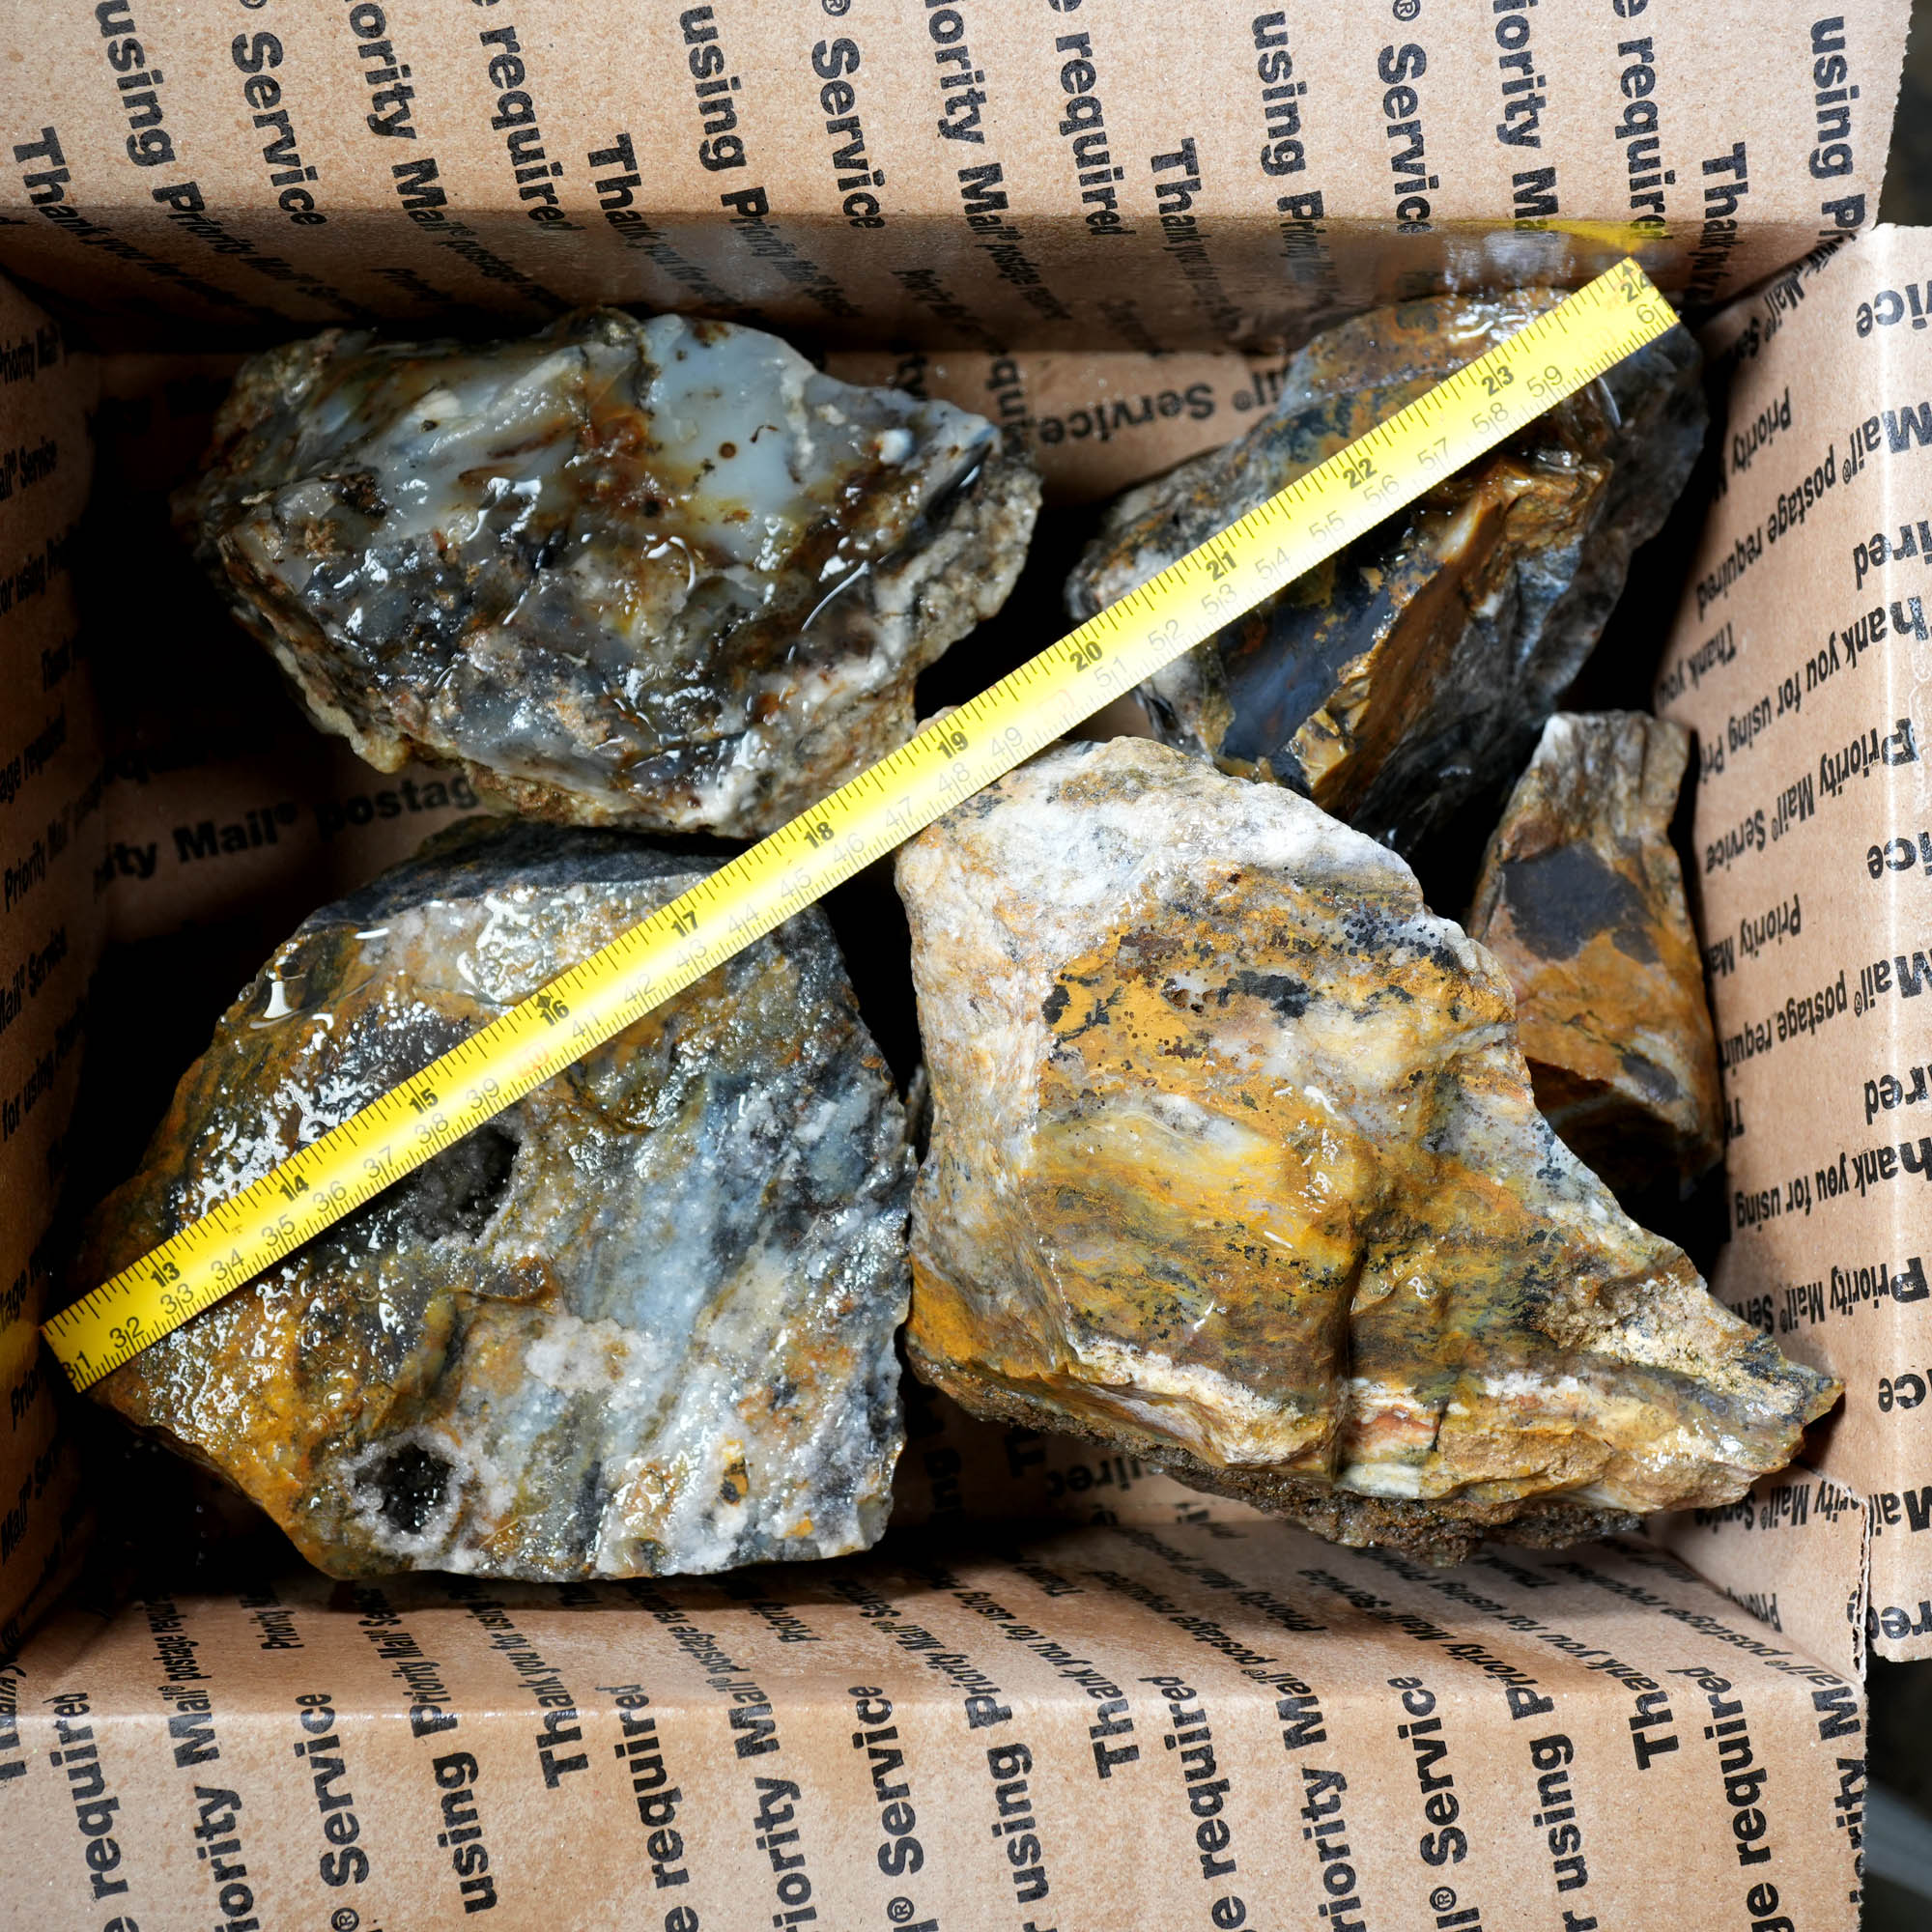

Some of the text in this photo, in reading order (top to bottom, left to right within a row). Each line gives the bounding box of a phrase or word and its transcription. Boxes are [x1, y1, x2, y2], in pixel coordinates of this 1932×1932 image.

[346, 0, 417, 141] ority
[1251, 11, 1307, 177] using
[1809, 15, 1860, 179] using
[13, 127, 112, 236] Thank
[95, 0, 177, 167] using
[152, 181, 259, 254] Priority
[231, 31, 328, 226] Service
[479, 25, 585, 231] required
[679, 5, 798, 259] using Priority
[811, 37, 886, 228] Service
[1055, 32, 1136, 236] required
[1378, 43, 1439, 234] Service
[1615, 36, 1676, 239] require
[587, 132, 668, 241] Thank
[1151, 137, 1210, 243] Thank
[1038, 382, 1216, 444] Service
[1730, 386, 1793, 474] Priority
[1768, 444, 1836, 544] postage
[1696, 527, 1762, 621] required
[1688, 621, 1737, 690] Thank
[1728, 595, 1932, 753] hank you for using
[150, 1262, 181, 1288] 13
[279, 1175, 310, 1202] 14
[409, 1088, 439, 1115] 15
[538, 999, 570, 1027] 16
[671, 910, 699, 938] 17
[804, 821, 836, 849] 18
[937, 731, 969, 759] 19
[1069, 641, 1103, 672] 20
[1206, 551, 1237, 582] 21
[1343, 458, 1378, 489] 22
[1481, 365, 1515, 397] 23
[1706, 718, 1920, 873] Priority Mail® Service
[5, 838, 46, 913] Priority
[62, 365, 1563, 1381] 31 32 33 34 35 36 37 38 39 41 42 43 44 45 46 47 48 49 51 52 53 54 55 56 57 58 59
[1740, 894, 1802, 958] Priority
[1776, 971, 1848, 1042] postage
[1864, 1065, 1932, 1125] red
[1736, 1184, 1780, 1232] using
[1786, 1175, 1813, 1216] for
[1815, 1151, 1850, 1202] you
[1779, 1281, 1825, 1333] Mail®
[1830, 1257, 1930, 1316] Priority
[1760, 1484, 1810, 1530] Mail®
[153, 1634, 212, 1682] postage
[249, 1609, 304, 1650] Priority
[505, 1651, 562, 1676] you
[1027, 1642, 1093, 1668] you
[1168, 1615, 1279, 1666] postage
[1492, 1614, 1548, 1633] for
[1535, 1634, 1612, 1659] you
[1661, 1606, 1794, 1659] postage
[157, 1685, 220, 1769] Mail®
[391, 1661, 459, 1739] Priority
[518, 1676, 589, 1789] Thank
[923, 1651, 1013, 1731] Priority
[1058, 1667, 1141, 1780] Thank
[1240, 1668, 1327, 1750] Mail®
[1440, 1641, 1556, 1721] Priority
[1585, 1659, 1680, 1771] Thank
[1762, 1660, 1862, 1741] Mail®
[43, 1691, 129, 1902] required
[294, 1693, 370, 1888] Service
[595, 1684, 691, 1889] required
[668, 1625, 817, 1932] iority Mail® postage
[847, 1686, 925, 1877] Service
[1138, 1676, 1237, 1880] required
[1387, 1676, 1468, 1867] Service
[1530, 1734, 1589, 1893] using
[1665, 1665, 1772, 1867] required
[433, 1750, 498, 1915] using
[987, 1743, 1050, 1904] using
